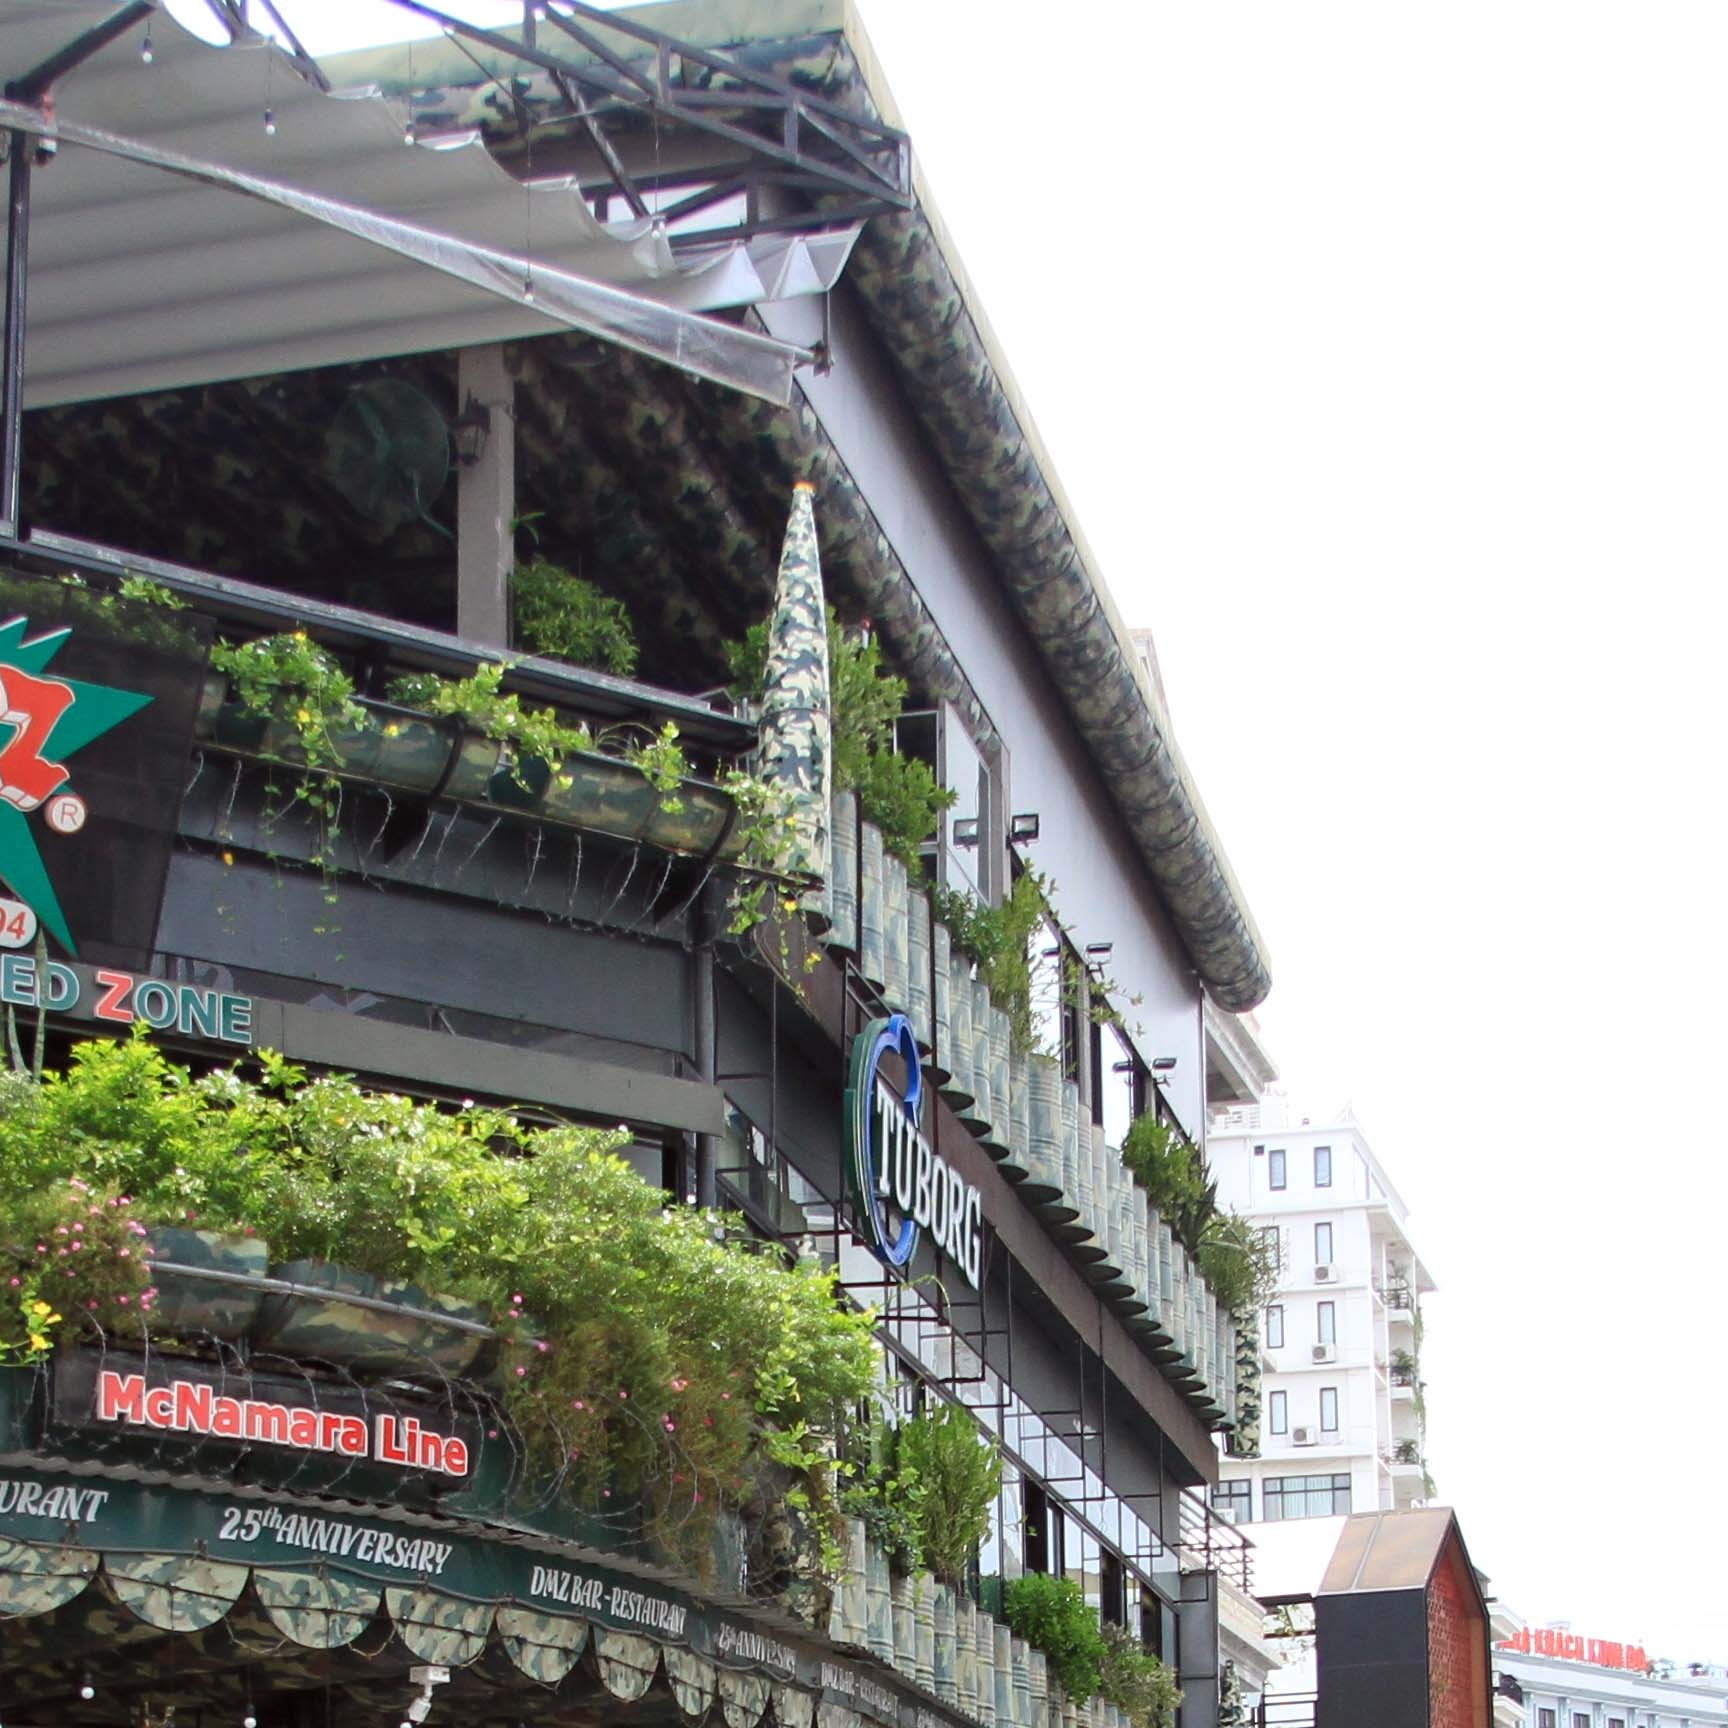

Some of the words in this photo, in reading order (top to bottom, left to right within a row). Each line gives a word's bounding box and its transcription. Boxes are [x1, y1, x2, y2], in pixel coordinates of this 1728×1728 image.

[95, 969, 253, 1045] ZONE
[876, 1075, 982, 1291] TUBORG
[99, 1370, 368, 1458] McNamara
[373, 1413, 469, 1477] Line
[219, 1505, 281, 1543] 25th
[278, 1514, 453, 1576] ANNIVERSARY
[530, 1565, 570, 1601] DMZ
[571, 1575, 603, 1610] BAR
[610, 1589, 687, 1635] RESTAURANT
